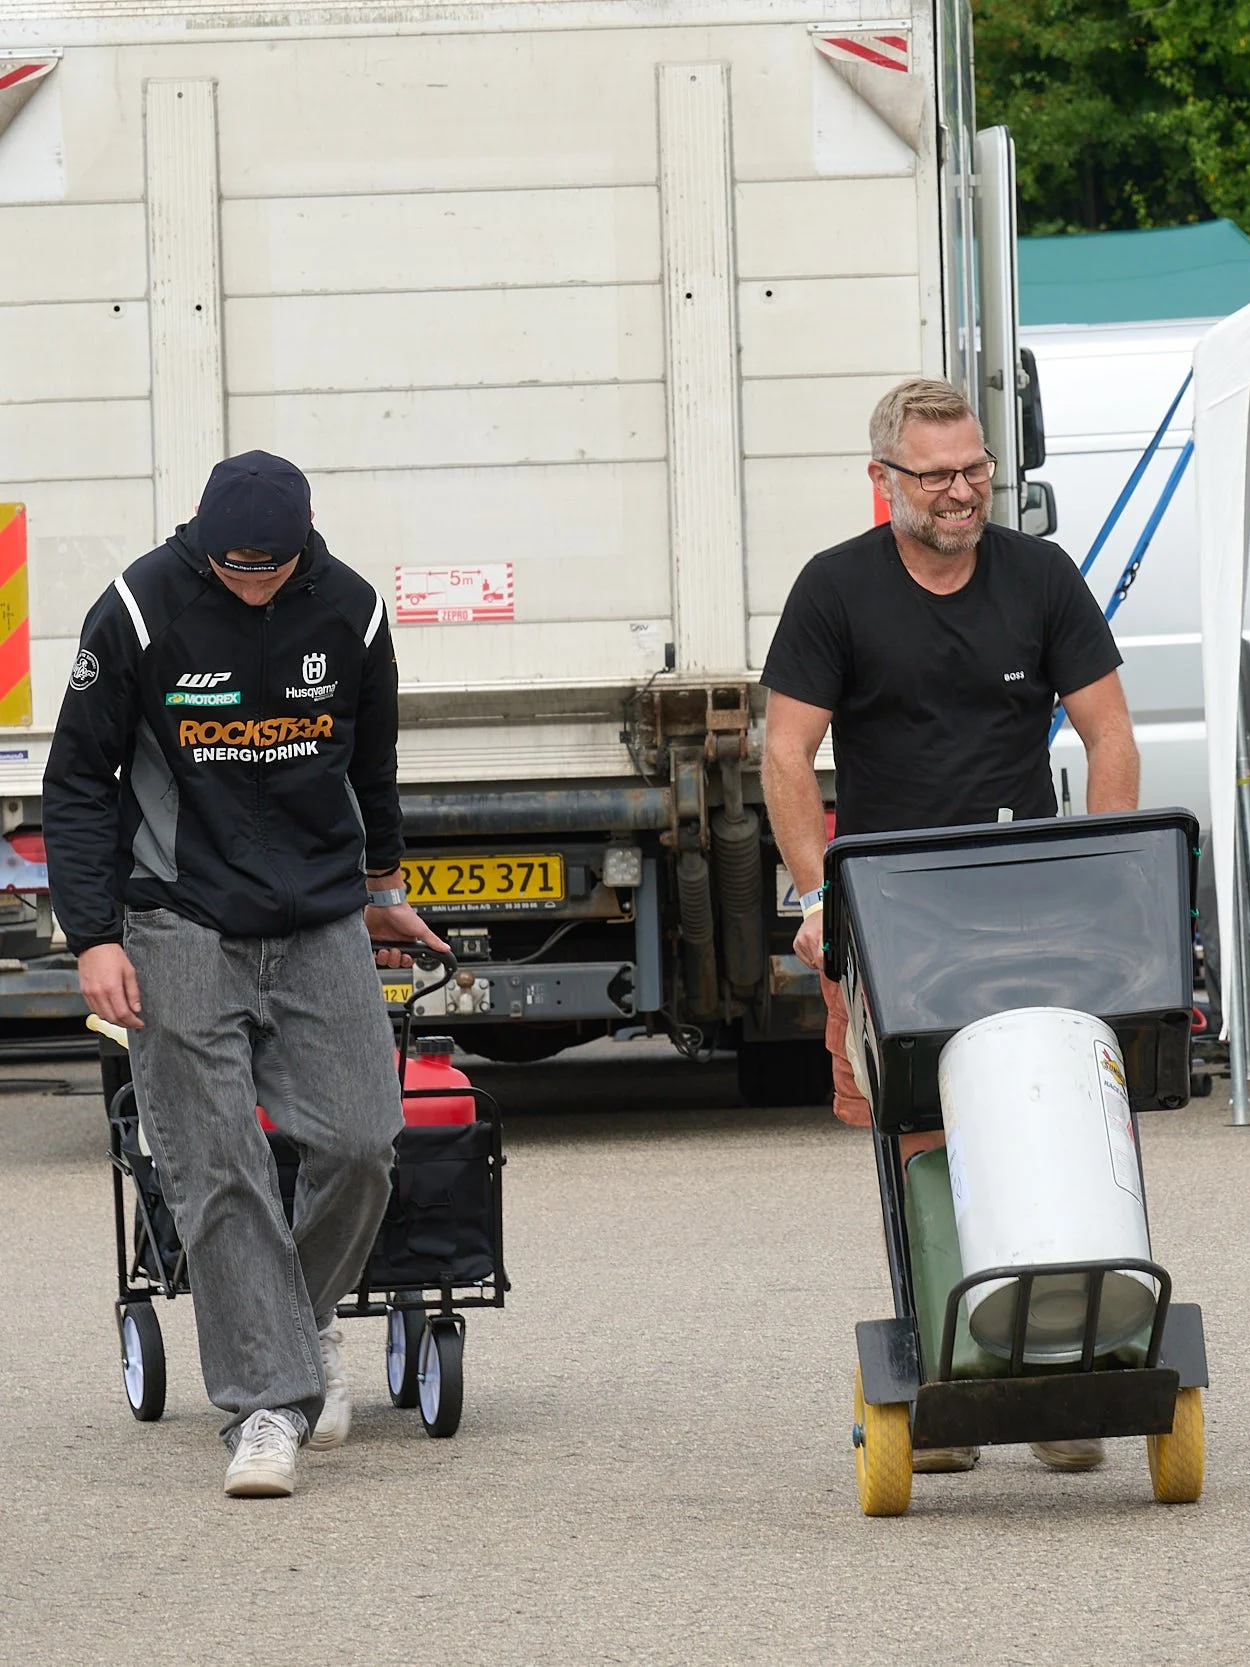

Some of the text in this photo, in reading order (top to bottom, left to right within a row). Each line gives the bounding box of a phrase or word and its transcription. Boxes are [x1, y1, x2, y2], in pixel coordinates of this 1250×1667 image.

[449, 570, 474, 586] 5 m
[442, 610, 469, 621] ZEPRO
[176, 671, 232, 688] WP
[1003, 670, 1025, 682] BOSS
[184, 692, 239, 705] MOTOREX
[179, 713, 334, 747] ROCKSTAR
[193, 740, 319, 764] ENERGY DRINK
[447, 864, 486, 896] 25
[496, 862, 554, 894] 371
[384, 990, 398, 1001] 12
